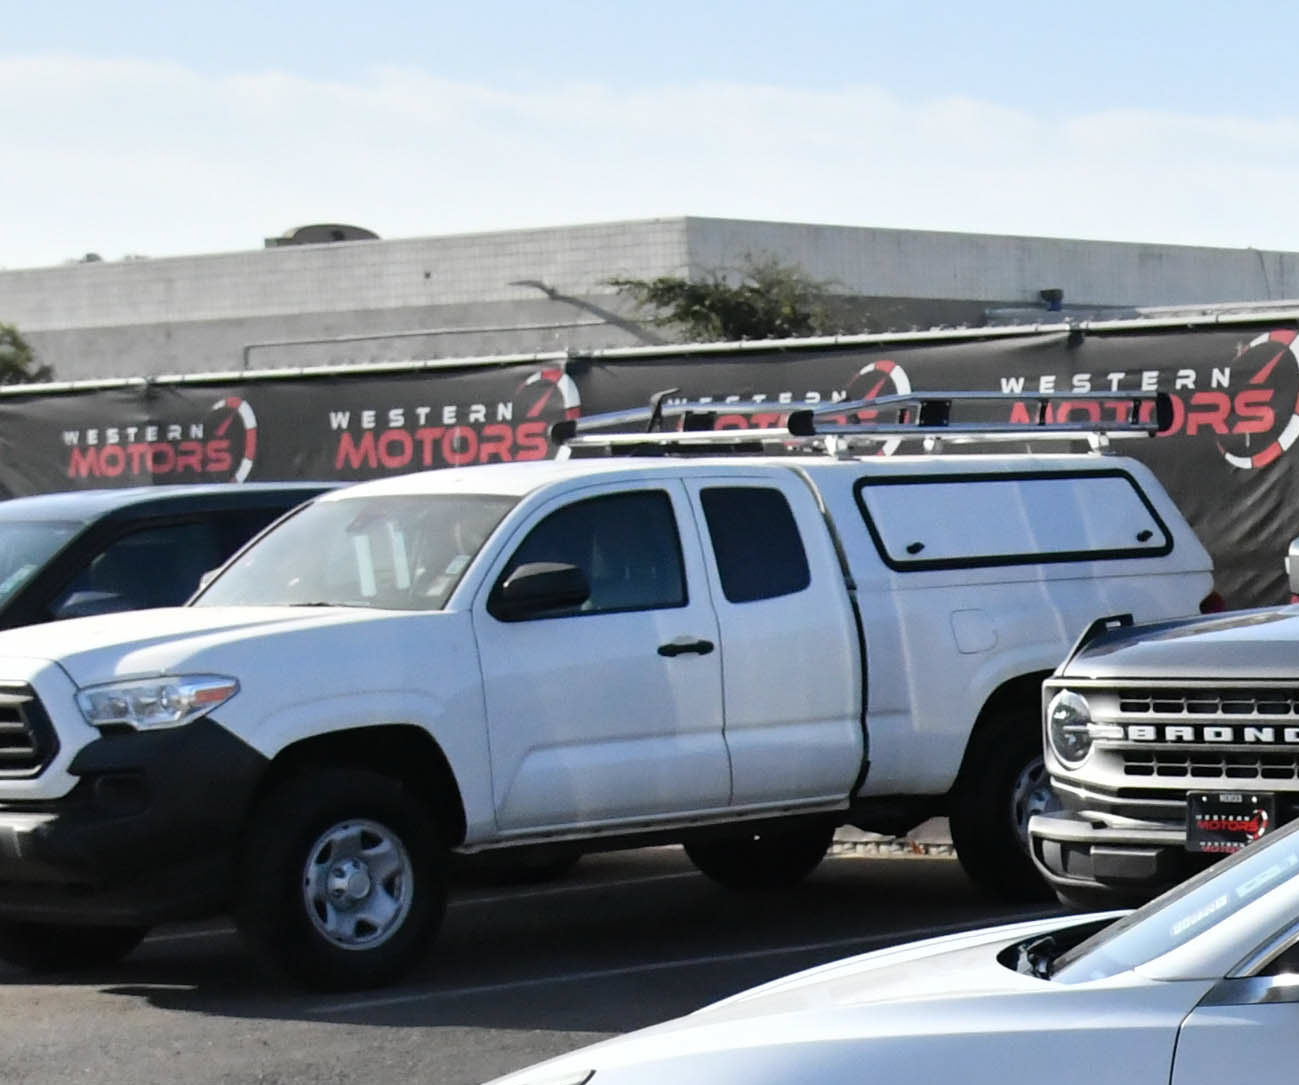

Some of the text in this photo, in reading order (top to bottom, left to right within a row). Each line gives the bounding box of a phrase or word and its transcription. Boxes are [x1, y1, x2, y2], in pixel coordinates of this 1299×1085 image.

[1001, 367, 1230, 393] WESTERN
[329, 402, 513, 430] WESTERN
[63, 424, 203, 446] WESTERN
[336, 422, 548, 470] MOTORS
[68, 439, 232, 478] MOTORS
